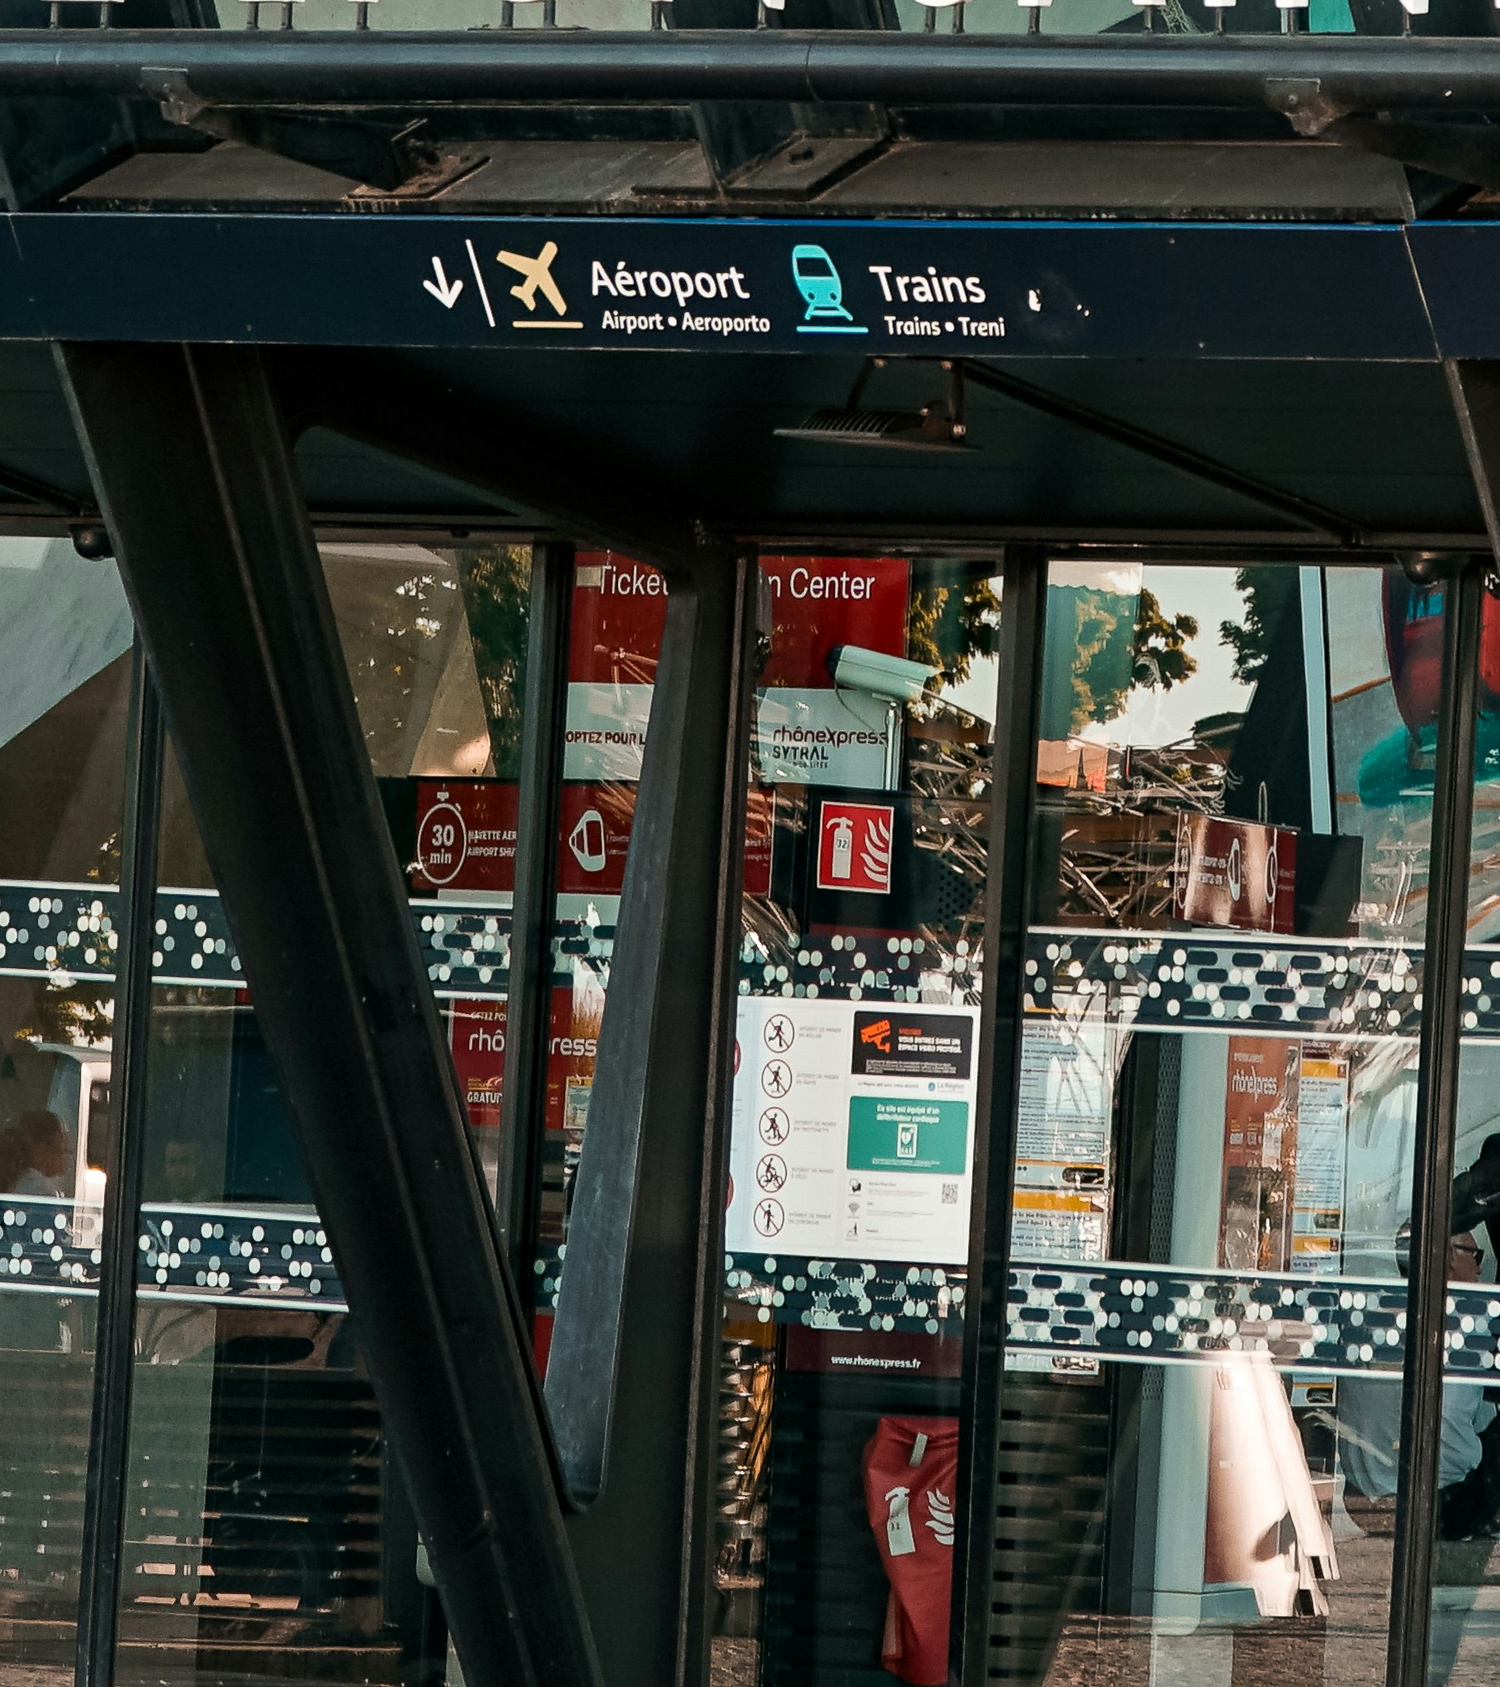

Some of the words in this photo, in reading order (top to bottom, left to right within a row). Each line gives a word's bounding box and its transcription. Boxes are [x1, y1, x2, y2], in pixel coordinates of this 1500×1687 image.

[591, 260, 750, 306] Aéroport
[868, 265, 986, 303] Trains
[601, 311, 663, 333] Airport
[681, 312, 770, 335] Aeroporto
[884, 315, 941, 336] Trains
[958, 316, 1005, 337] Treni
[790, 567, 876, 599] Center
[604, 731, 633, 745] POUR
[771, 745, 829, 761] SYTRAL
[432, 825, 454, 847] 30
[429, 850, 452, 865] min
[831, 1355, 921, 1369] www.rhonexpress.fr
